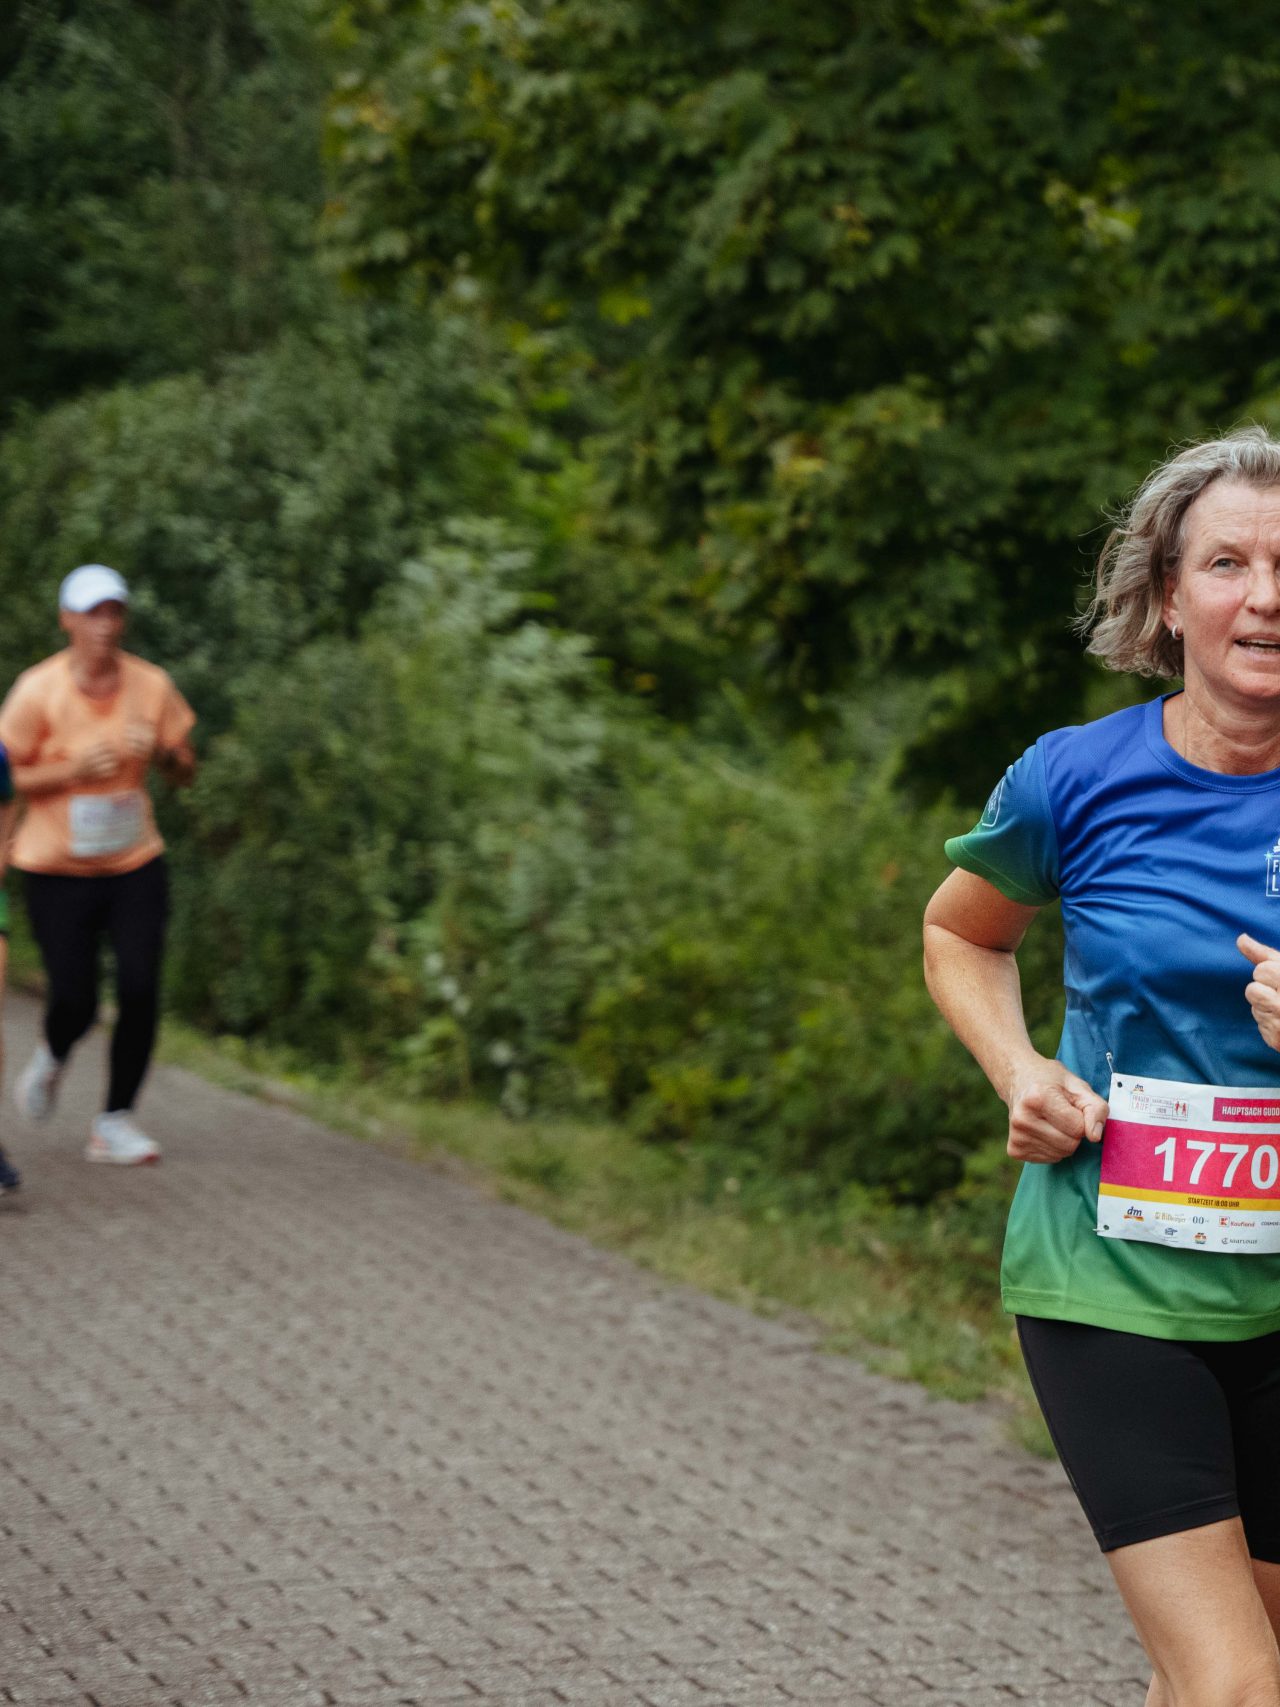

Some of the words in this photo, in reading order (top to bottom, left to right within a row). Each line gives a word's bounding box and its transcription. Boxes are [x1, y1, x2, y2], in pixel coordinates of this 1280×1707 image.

[1222, 1105, 1262, 1116] HAUPTSACH
[1154, 1136, 1279, 1190] 1770
[1187, 1197, 1214, 1206] STARTZEIT
[1126, 1205, 1142, 1216] dm
